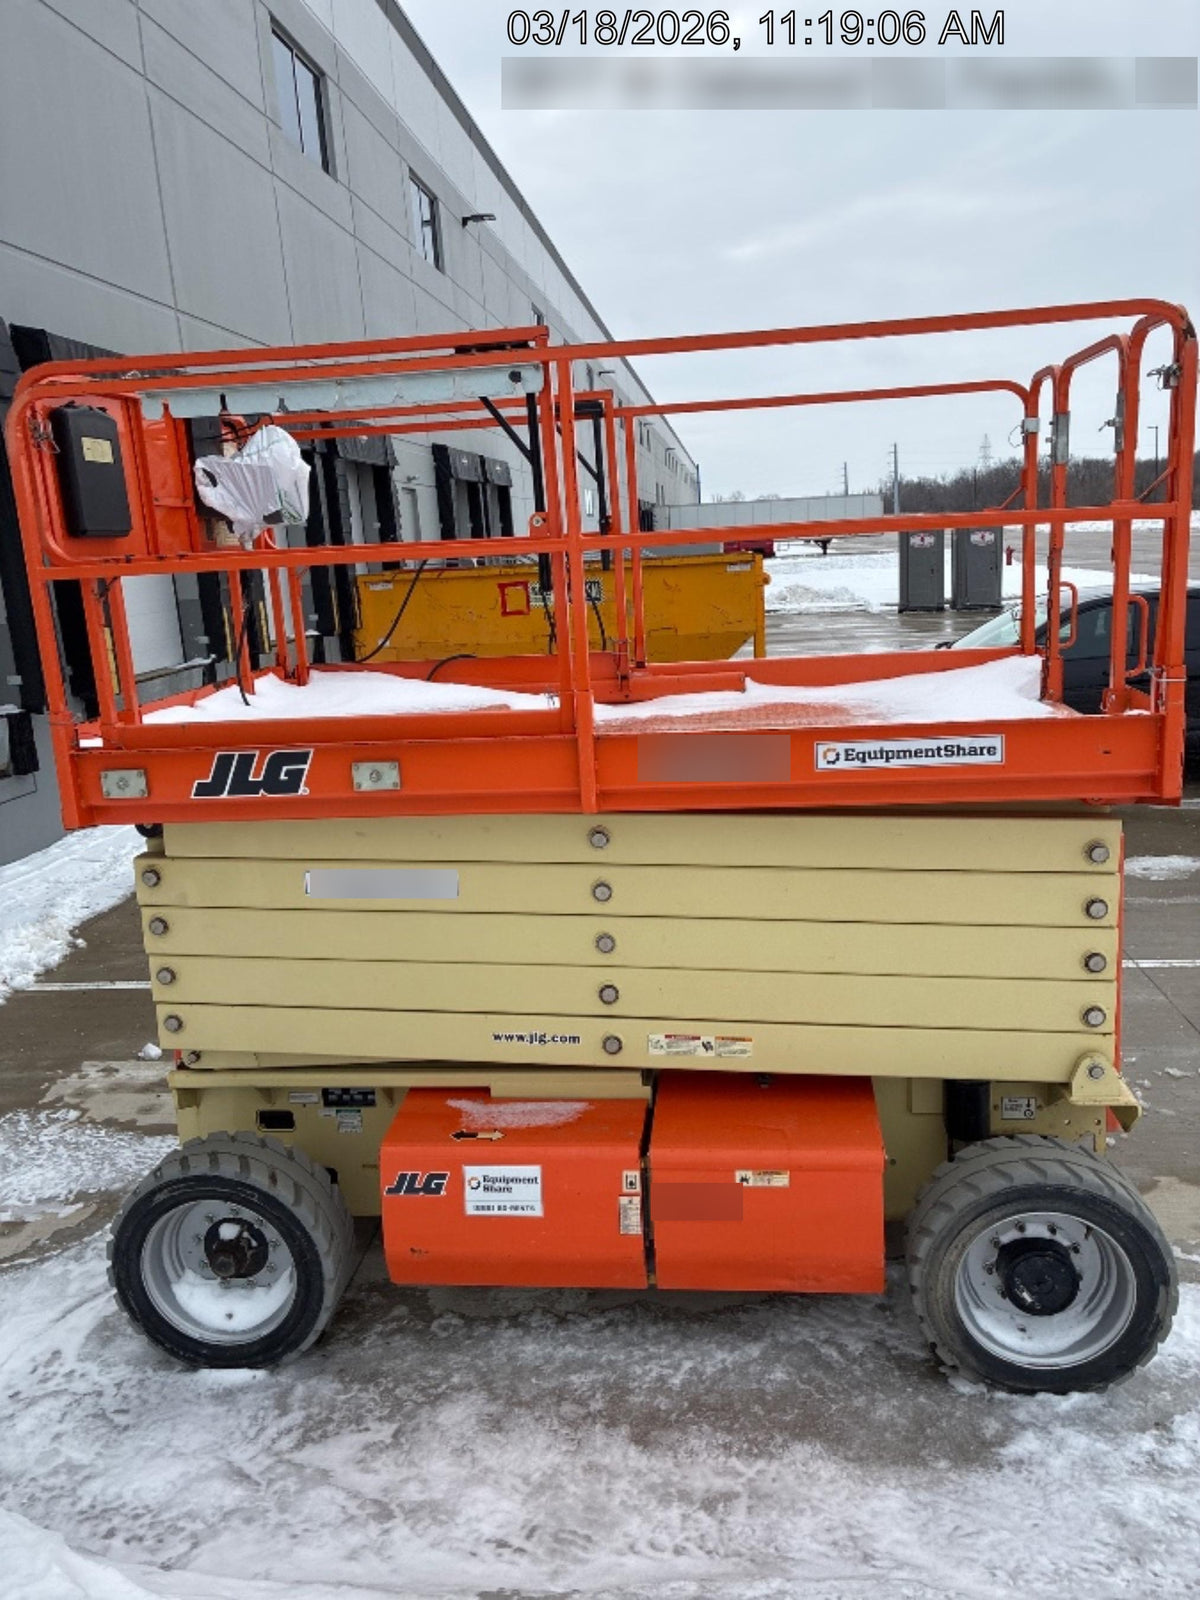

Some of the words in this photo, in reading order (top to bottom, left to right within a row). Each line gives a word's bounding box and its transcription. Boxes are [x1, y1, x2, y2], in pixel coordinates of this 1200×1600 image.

[843, 744, 997, 764] EquipmentShare
[190, 748, 314, 798] JLG
[492, 1032, 581, 1045] www.jlg.com
[384, 1171, 450, 1196] JLG
[482, 1175, 539, 1187] Equipment
[482, 1185, 513, 1194] Share
